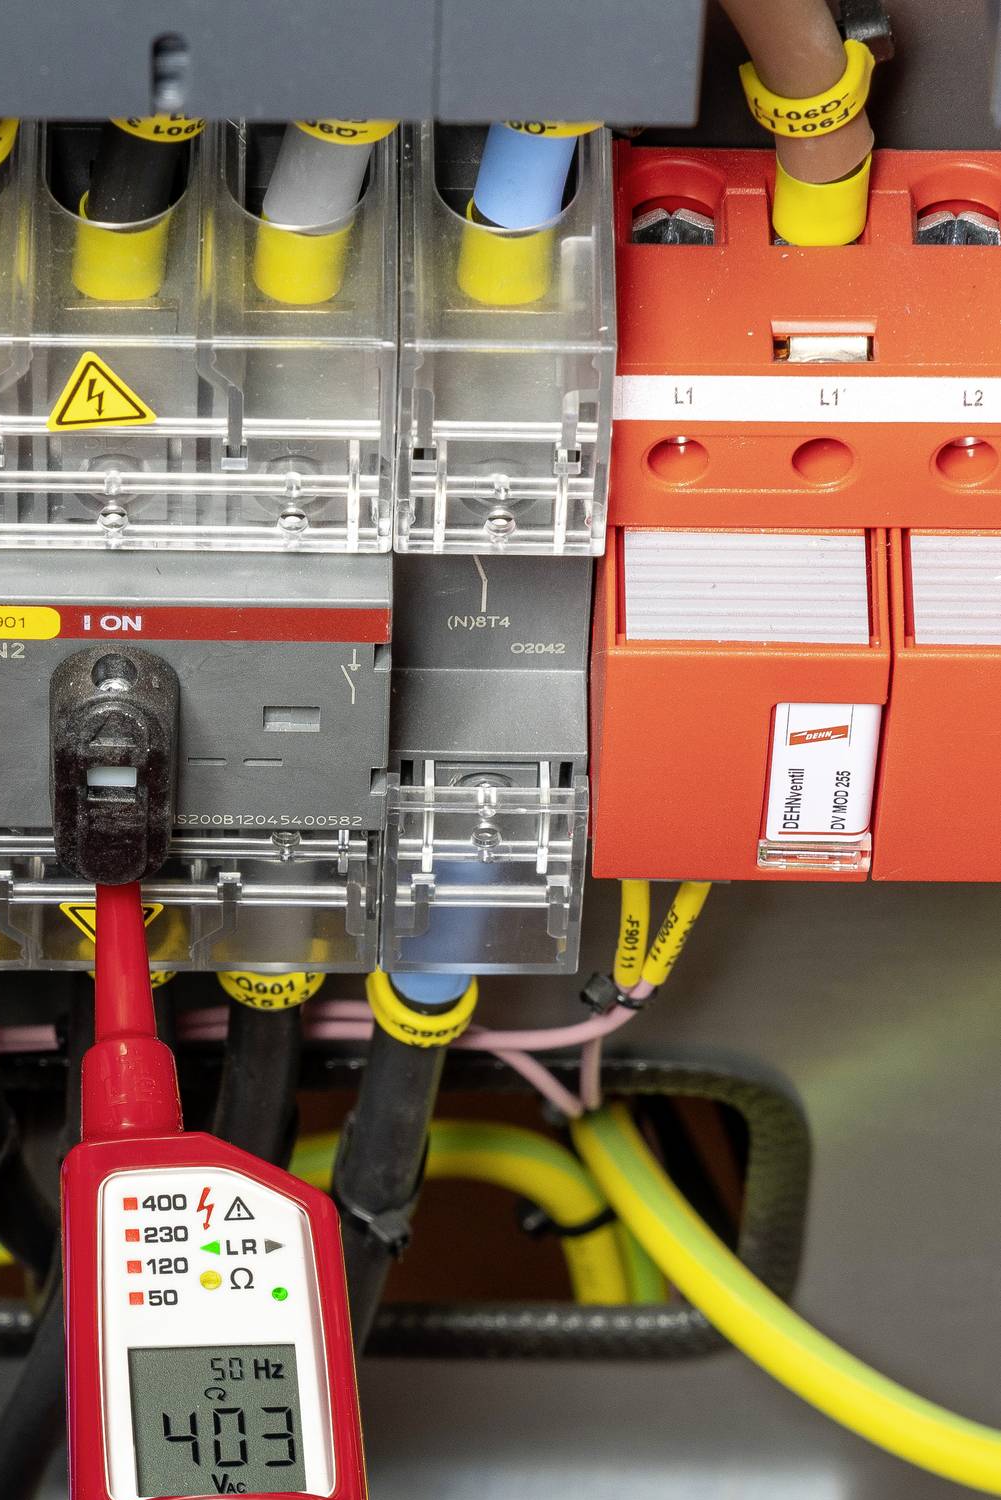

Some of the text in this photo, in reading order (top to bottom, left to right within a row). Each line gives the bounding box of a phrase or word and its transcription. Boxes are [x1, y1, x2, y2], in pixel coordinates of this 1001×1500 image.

[774, 93, 849, 121] -Q901
[788, 102, 856, 133] -F901
[674, 387, 693, 405] L1
[963, 389, 984, 407] L2
[100, 614, 142, 632] ON
[447, 615, 512, 631] (N)8T4
[805, 730, 833, 741] DEHN
[782, 768, 805, 829] DEHNventil
[831, 770, 851, 830] DV MOD 255
[142, 1194, 187, 1212] 400
[144, 1225, 189, 1243] 230
[146, 1257, 189, 1275] 120
[149, 1289, 178, 1306] 50
[211, 1357, 284, 1380] 50 Hz
[162, 1406, 296, 1467] 403
